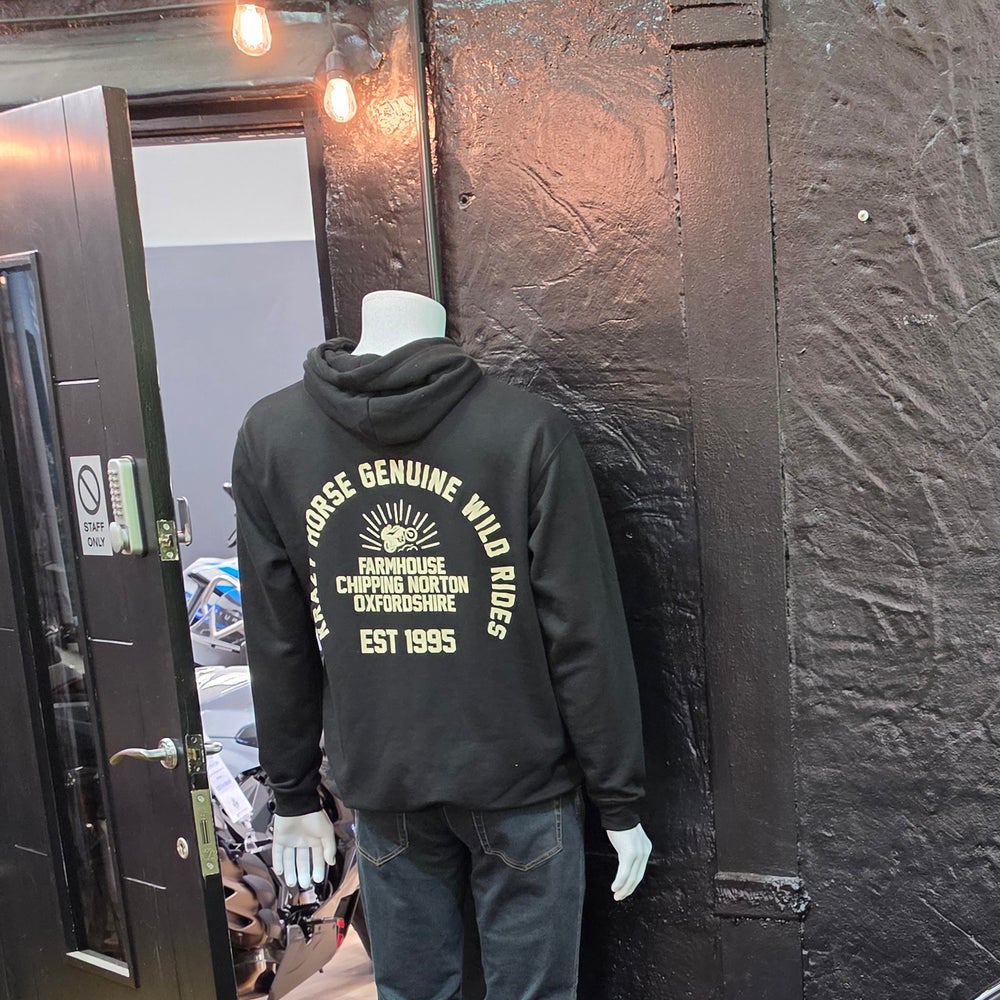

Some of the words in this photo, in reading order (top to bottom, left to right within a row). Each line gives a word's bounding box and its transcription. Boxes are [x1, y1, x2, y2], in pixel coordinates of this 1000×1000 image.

[84, 521, 105, 532] STAFF
[87, 536, 105, 547] ONLY
[358, 459, 462, 502] GENUINE
[461, 493, 511, 558] WILD
[487, 566, 516, 640] RIDES
[358, 556, 446, 575] FARMHOUSE
[335, 575, 404, 594] CHIPPING
[407, 575, 470, 594] NORTON
[353, 594, 457, 613] OXFORDSHIRE
[360, 628, 399, 654] EST
[404, 628, 457, 654] 1995
